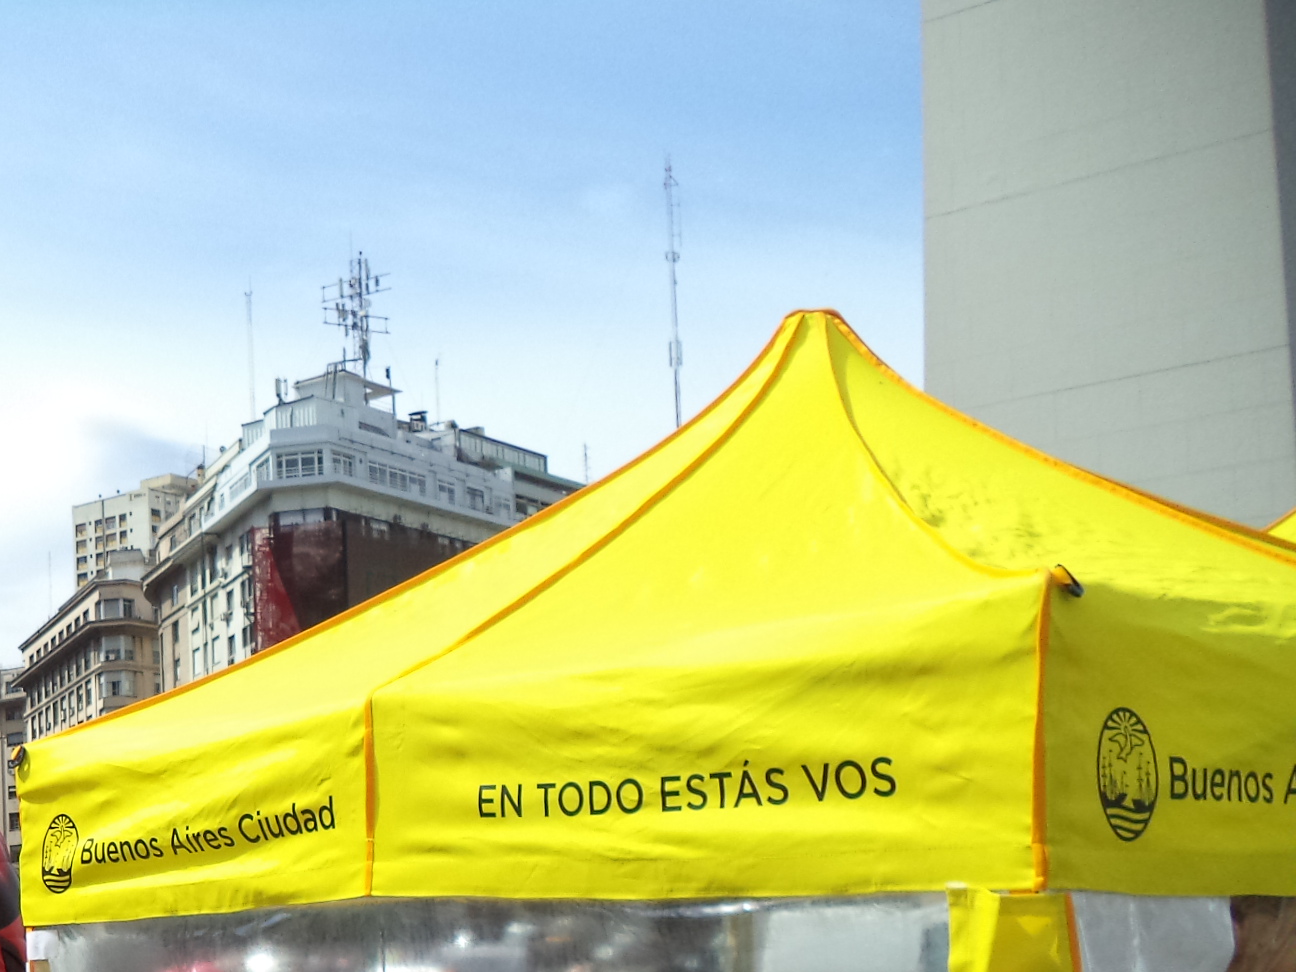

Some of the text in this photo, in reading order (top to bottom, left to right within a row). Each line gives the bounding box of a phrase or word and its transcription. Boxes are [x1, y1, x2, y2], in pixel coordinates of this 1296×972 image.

[478, 756, 897, 818] EN TODO ESTÁS VOS
[1169, 756, 1275, 804] Buenos
[80, 795, 337, 865] Buenos Aires Ciudad
